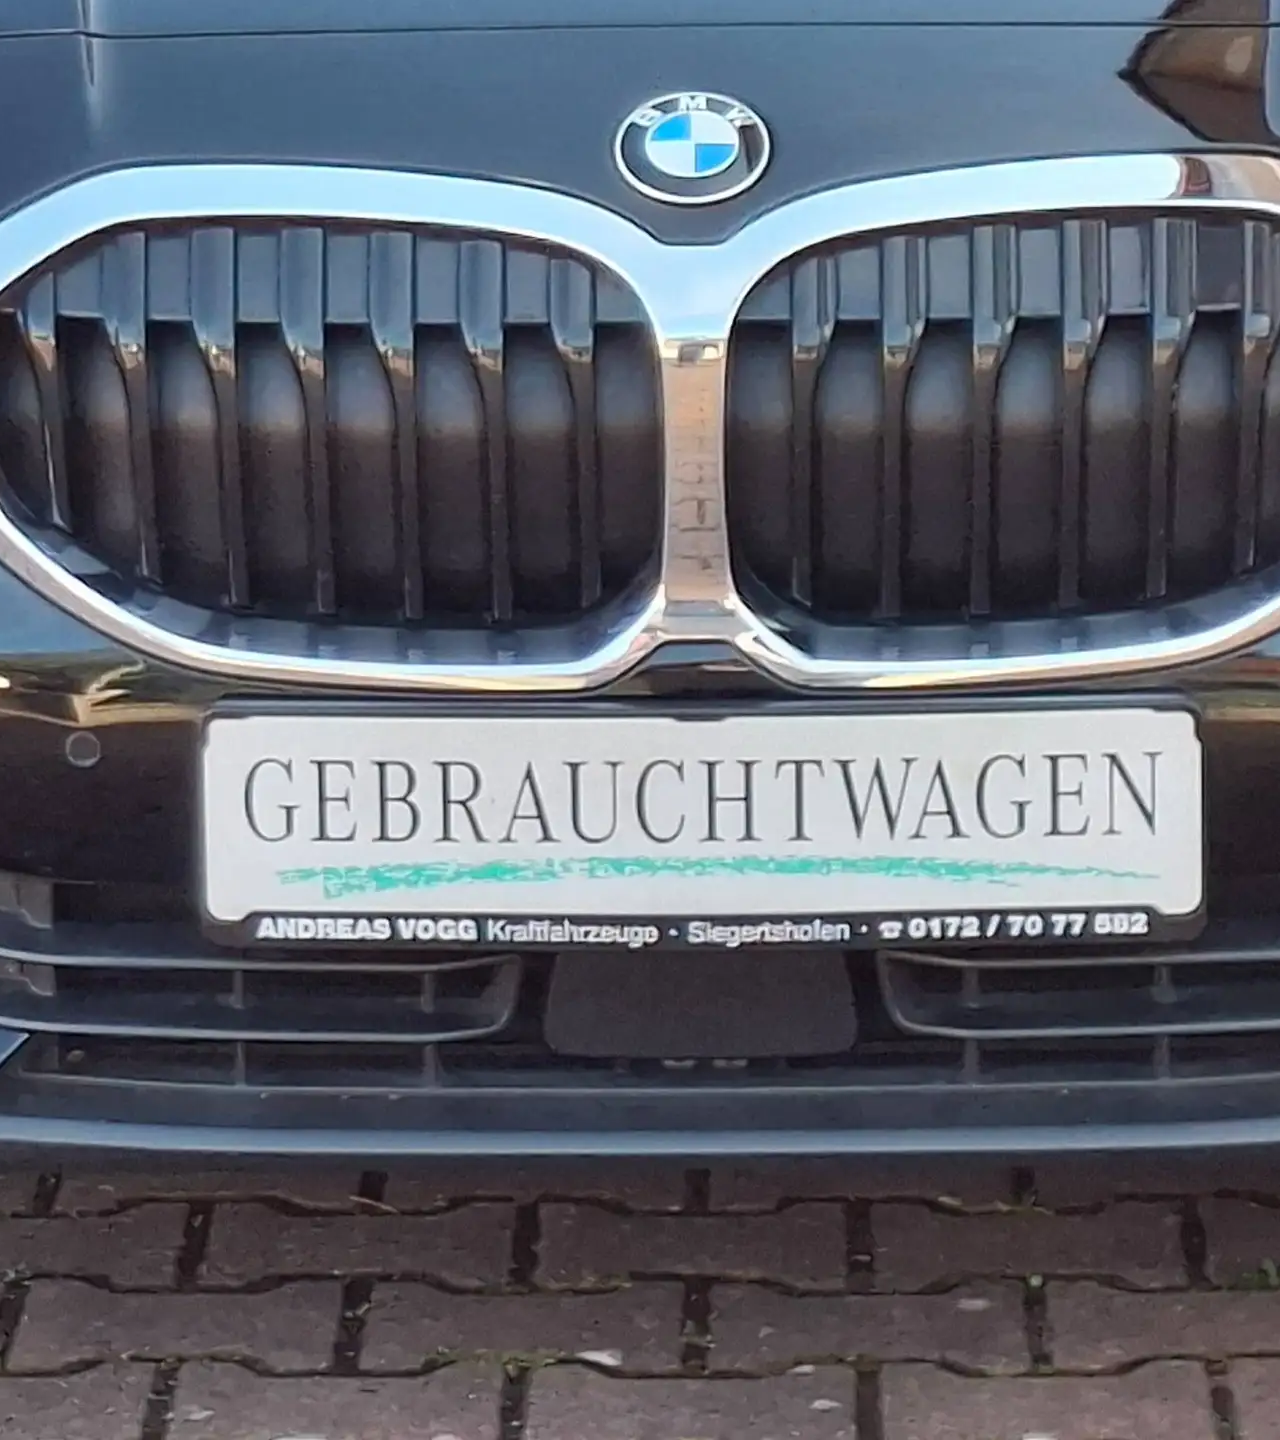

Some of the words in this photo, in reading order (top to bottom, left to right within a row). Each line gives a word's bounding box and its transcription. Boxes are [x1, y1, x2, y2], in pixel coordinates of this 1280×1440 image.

[633, 95, 757, 127] BMW
[243, 750, 1164, 844] GEBRAUCHTWAGEN
[255, 916, 392, 941] ANDREAS
[397, 917, 478, 941] VOGG
[487, 918, 660, 949] Kraftfahrzeuge
[907, 915, 981, 939] 0172
[1006, 914, 1044, 937] 70
[1051, 912, 1087, 936] 77
